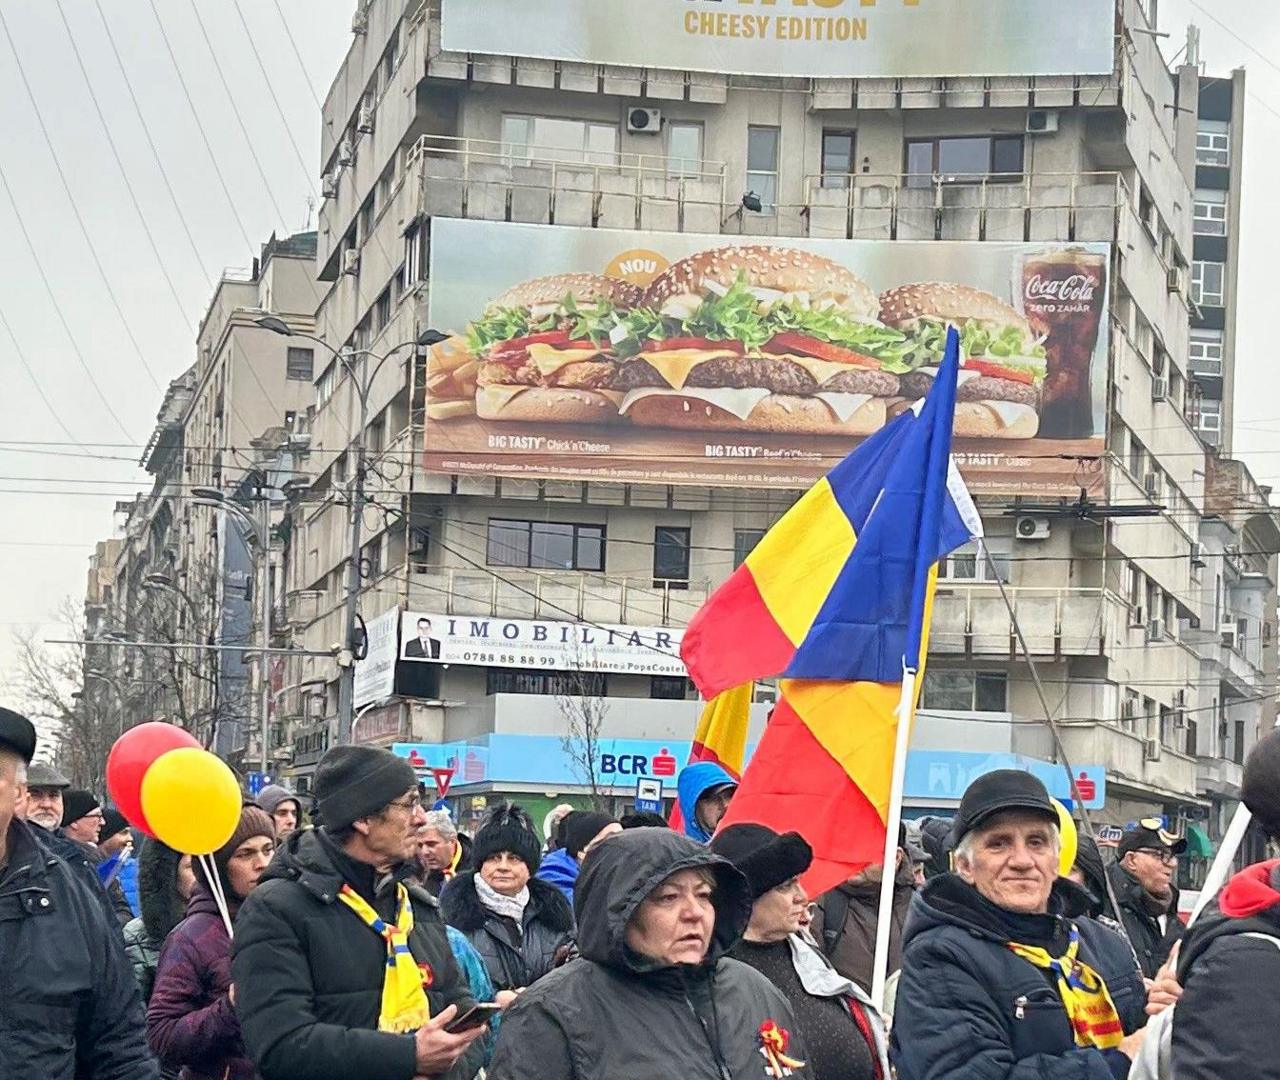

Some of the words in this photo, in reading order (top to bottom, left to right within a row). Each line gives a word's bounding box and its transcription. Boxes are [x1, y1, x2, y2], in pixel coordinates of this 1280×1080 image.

[684, 10, 770, 39] CHEESY
[775, 16, 867, 41] EDITION
[619, 258, 657, 275] NOU
[1025, 273, 1095, 300] Coca-Cola
[488, 435, 507, 448] BIG
[705, 445, 723, 457] BIG
[448, 619, 671, 649] IMOBILIAR
[463, 652, 495, 663] 0788
[500, 654, 515, 664] 88
[520, 655, 535, 665] 88
[540, 656, 556, 666] 99
[601, 754, 648, 775] BCR
[1100, 827, 1121, 839] dm
